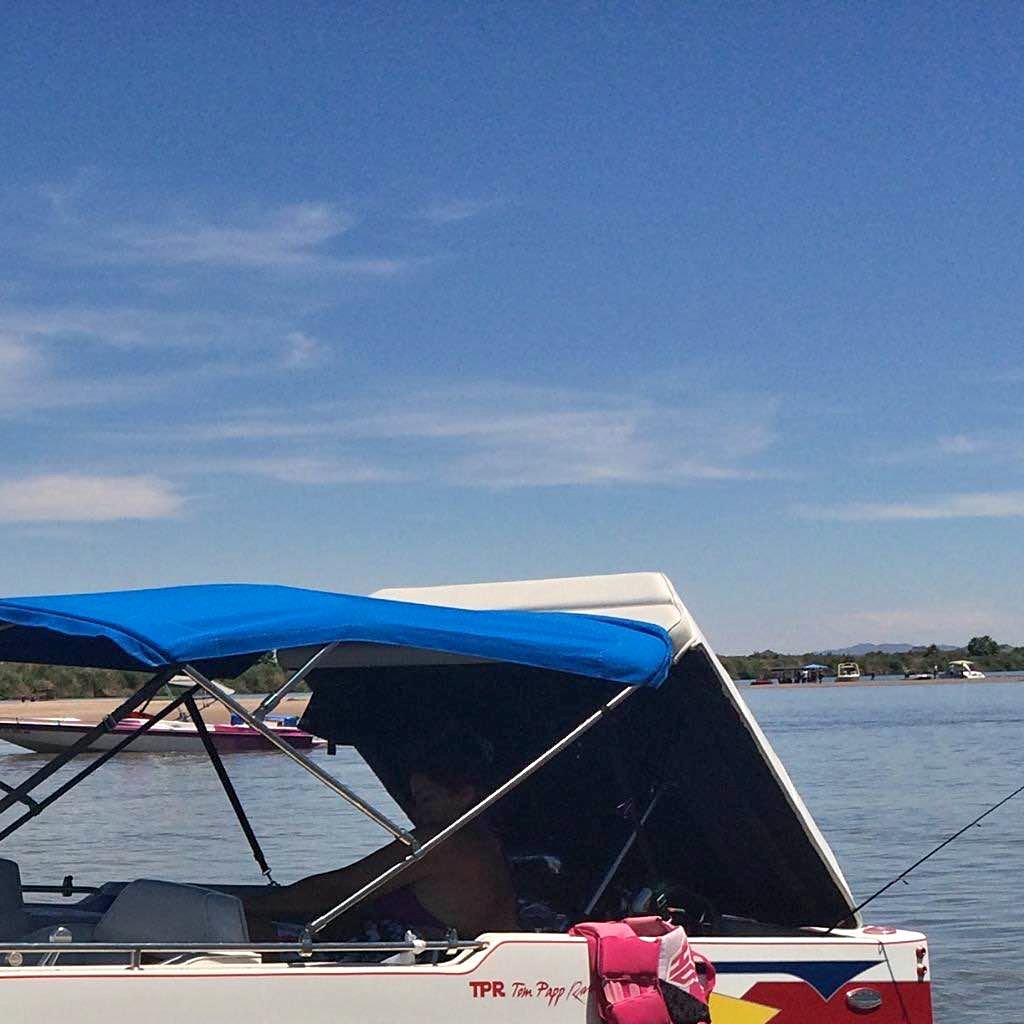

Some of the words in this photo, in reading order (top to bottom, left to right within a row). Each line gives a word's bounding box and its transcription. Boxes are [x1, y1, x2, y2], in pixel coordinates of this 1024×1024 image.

[469, 981, 506, 998] TPR
[511, 982, 533, 998] Tom
[536, 981, 566, 1007] Papp
